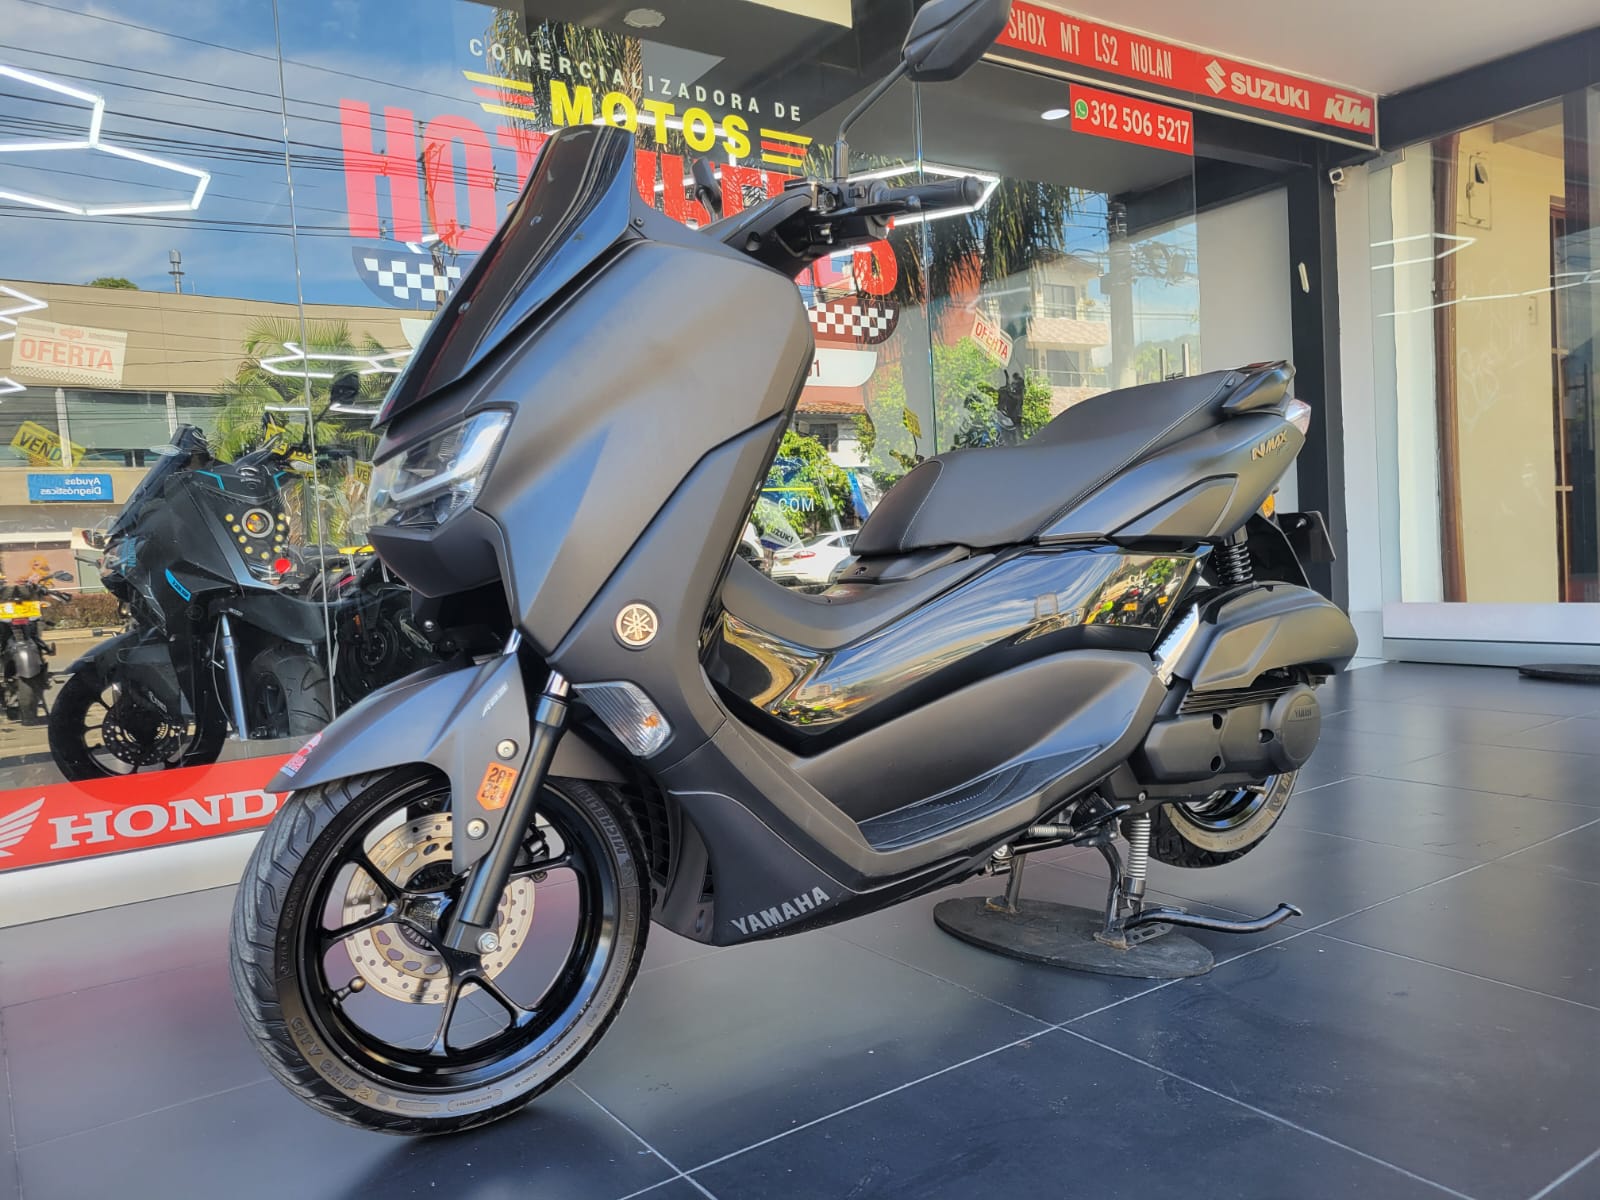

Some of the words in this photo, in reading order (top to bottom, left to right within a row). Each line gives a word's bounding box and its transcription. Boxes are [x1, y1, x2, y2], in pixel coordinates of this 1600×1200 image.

[1008, 8, 1047, 47] SHOX
[1060, 21, 1080, 56] MT
[1094, 31, 1119, 66] LS2
[1130, 41, 1173, 80] NOLAN
[469, 37, 760, 114] COMERCIALIZADORA
[774, 102, 801, 122] DE
[1230, 71, 1310, 111] SUZUKI
[549, 79, 752, 159] MOTOS
[1090, 100, 1118, 130] 312
[1122, 107, 1152, 137] 506
[1157, 115, 1189, 145] 5217
[1323, 93, 1371, 129] KTM
[20, 338, 113, 371] OFERTA
[975, 321, 1008, 360] OFERTA
[48, 788, 294, 849] HOND
[730, 886, 830, 935] YAMAHA
